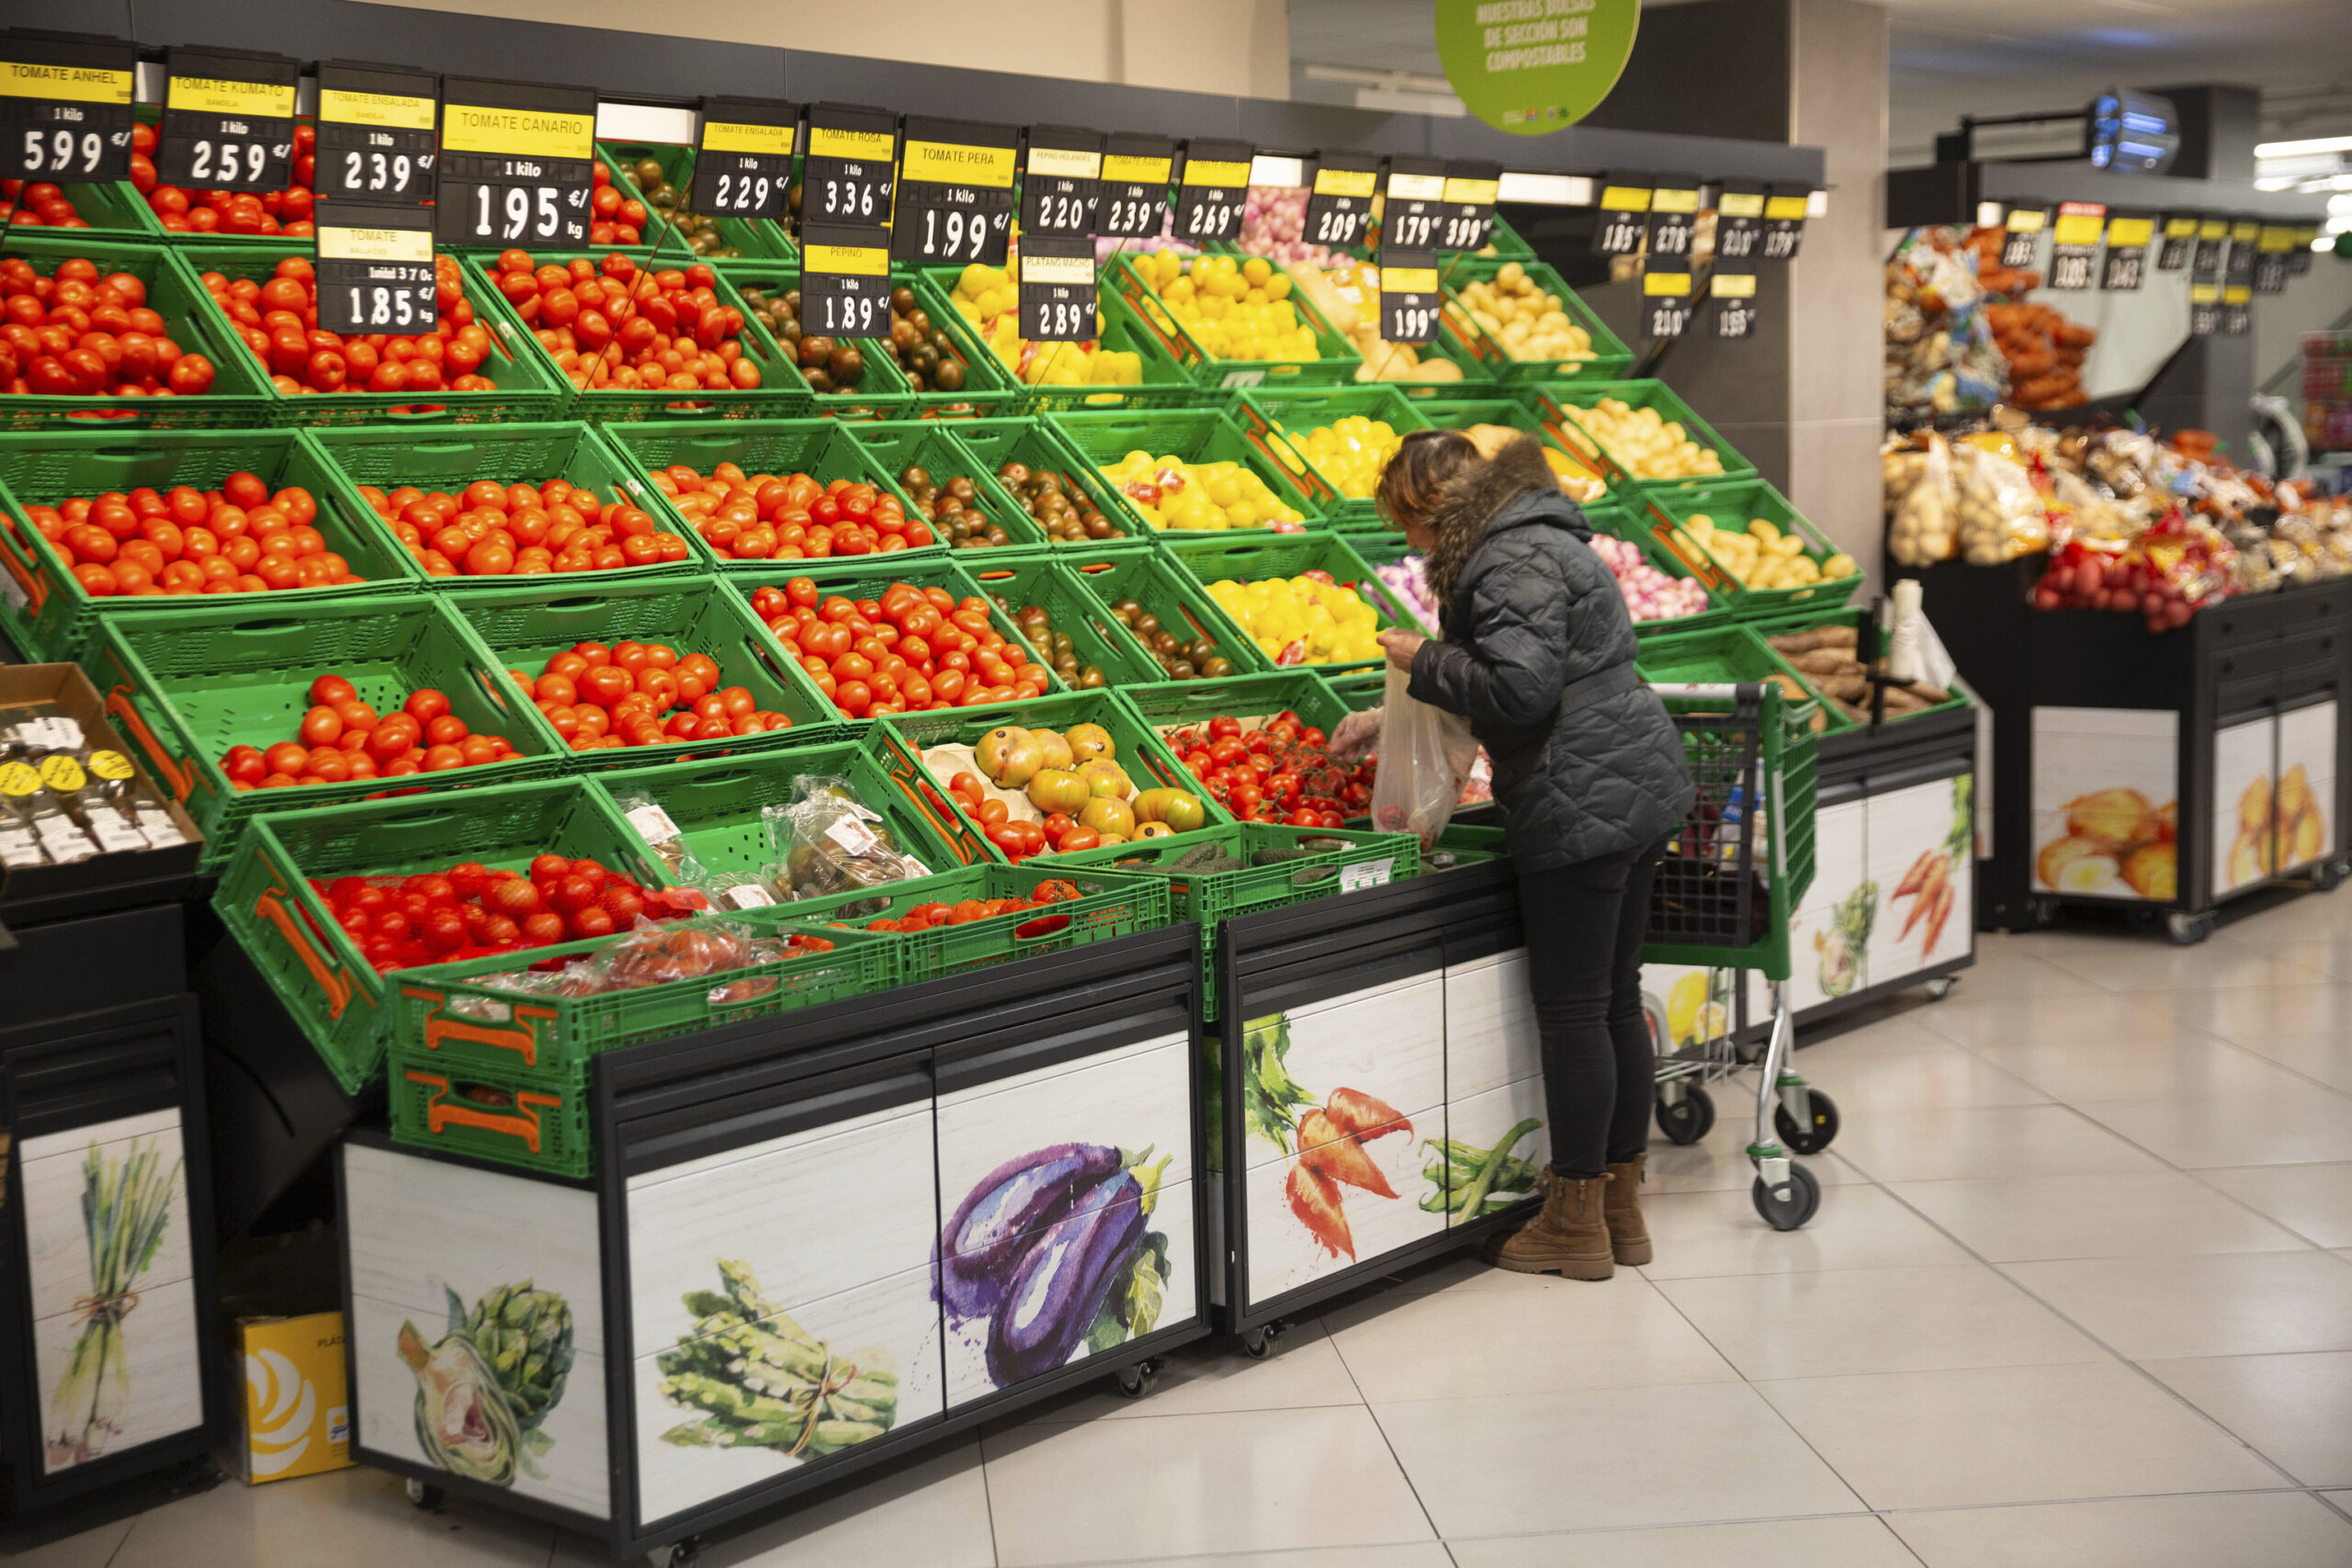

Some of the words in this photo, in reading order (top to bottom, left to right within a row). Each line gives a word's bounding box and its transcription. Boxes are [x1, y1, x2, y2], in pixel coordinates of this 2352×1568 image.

[1484, 27, 1504, 49] DE
[1486, 41, 1587, 73] COMPOSTABLES
[11, 64, 69, 81] TOMATE
[73, 70, 118, 85] ANHEL
[175, 76, 227, 93] TOMATE
[231, 81, 284, 97] KUMATO
[333, 92, 369, 106] TOMATE
[371, 95, 420, 108] ENSALADA
[54, 107, 62, 120] 1
[63, 107, 84, 121] kilo
[220, 121, 227, 133] 1
[228, 121, 249, 135] kilo
[461, 112, 518, 130] TOMATE
[521, 118, 582, 135] CANARIO
[714, 125, 742, 135] TOMATE
[744, 127, 784, 138] ENSALADA
[820, 129, 856, 141] TOMATE
[858, 132, 882, 144] ROSA
[369, 133, 376, 145] 1
[377, 133, 394, 146] kilo
[922, 148, 966, 163] TOMATE
[967, 152, 995, 165] PERA
[505, 162, 513, 175] 1
[514, 161, 542, 177] kilo
[739, 158, 743, 168] 1
[744, 158, 758, 171] kilo
[844, 164, 849, 175] 1
[849, 164, 862, 176] kilo
[1061, 181, 1074, 193] kilo
[947, 189, 953, 200] 1
[954, 188, 975, 204] kilo
[349, 230, 398, 243] TOMATE
[567, 221, 583, 239] kg
[831, 247, 863, 258] PEPINO
[1063, 258, 1091, 268] MACHO
[842, 280, 846, 289] 1
[846, 279, 859, 291] kilo
[1057, 288, 1069, 299] kilo
[419, 310, 434, 323] kg
